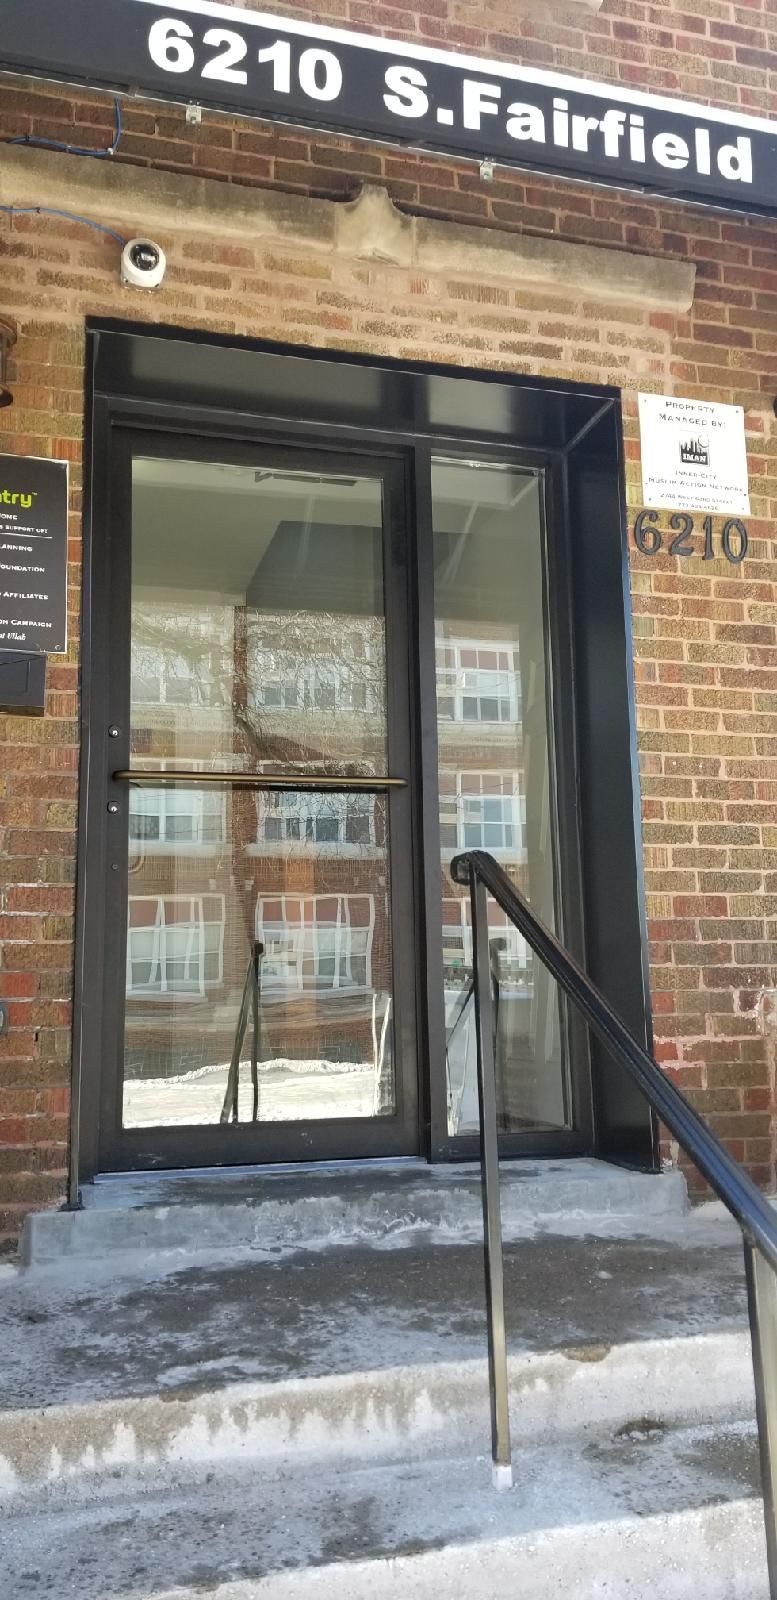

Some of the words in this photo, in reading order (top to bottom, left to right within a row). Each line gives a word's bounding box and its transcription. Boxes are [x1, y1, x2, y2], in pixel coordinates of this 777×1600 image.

[148, 18, 343, 101] 6210
[383, 65, 753, 183] S.Fairfield
[665, 401, 715, 413] PROPERTY
[659, 413, 708, 426] MANAGED
[682, 453, 707, 462] IMAN
[680, 480, 707, 488] ACTION
[709, 484, 743, 492] NETWORK
[634, 510, 748, 564] 6210
[0, 543, 33, 552] ANNING
[0, 563, 45, 573] OUNDATION
[3, 591, 49, 600] AFFILIATES
[10, 619, 52, 628] CAMPAIGN
